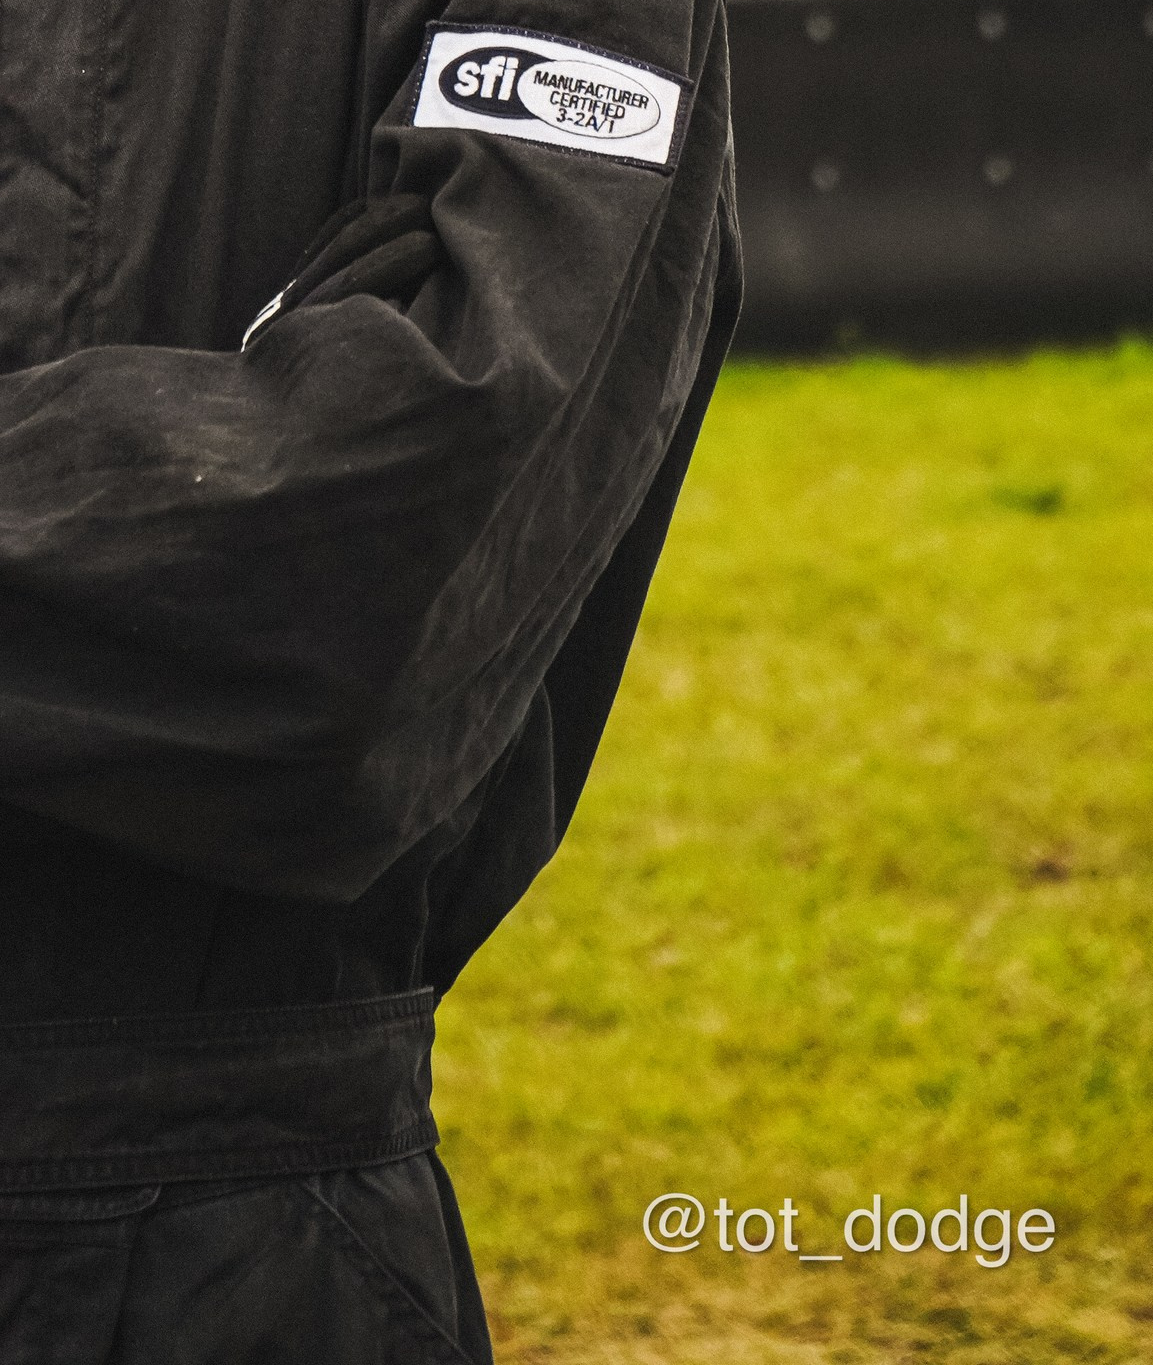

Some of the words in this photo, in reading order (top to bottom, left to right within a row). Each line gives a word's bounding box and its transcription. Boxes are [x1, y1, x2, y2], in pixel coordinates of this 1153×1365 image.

[453, 55, 519, 101] sfi
[533, 70, 649, 109] MANUFACTURER
[549, 90, 626, 119] CERTIFIED
